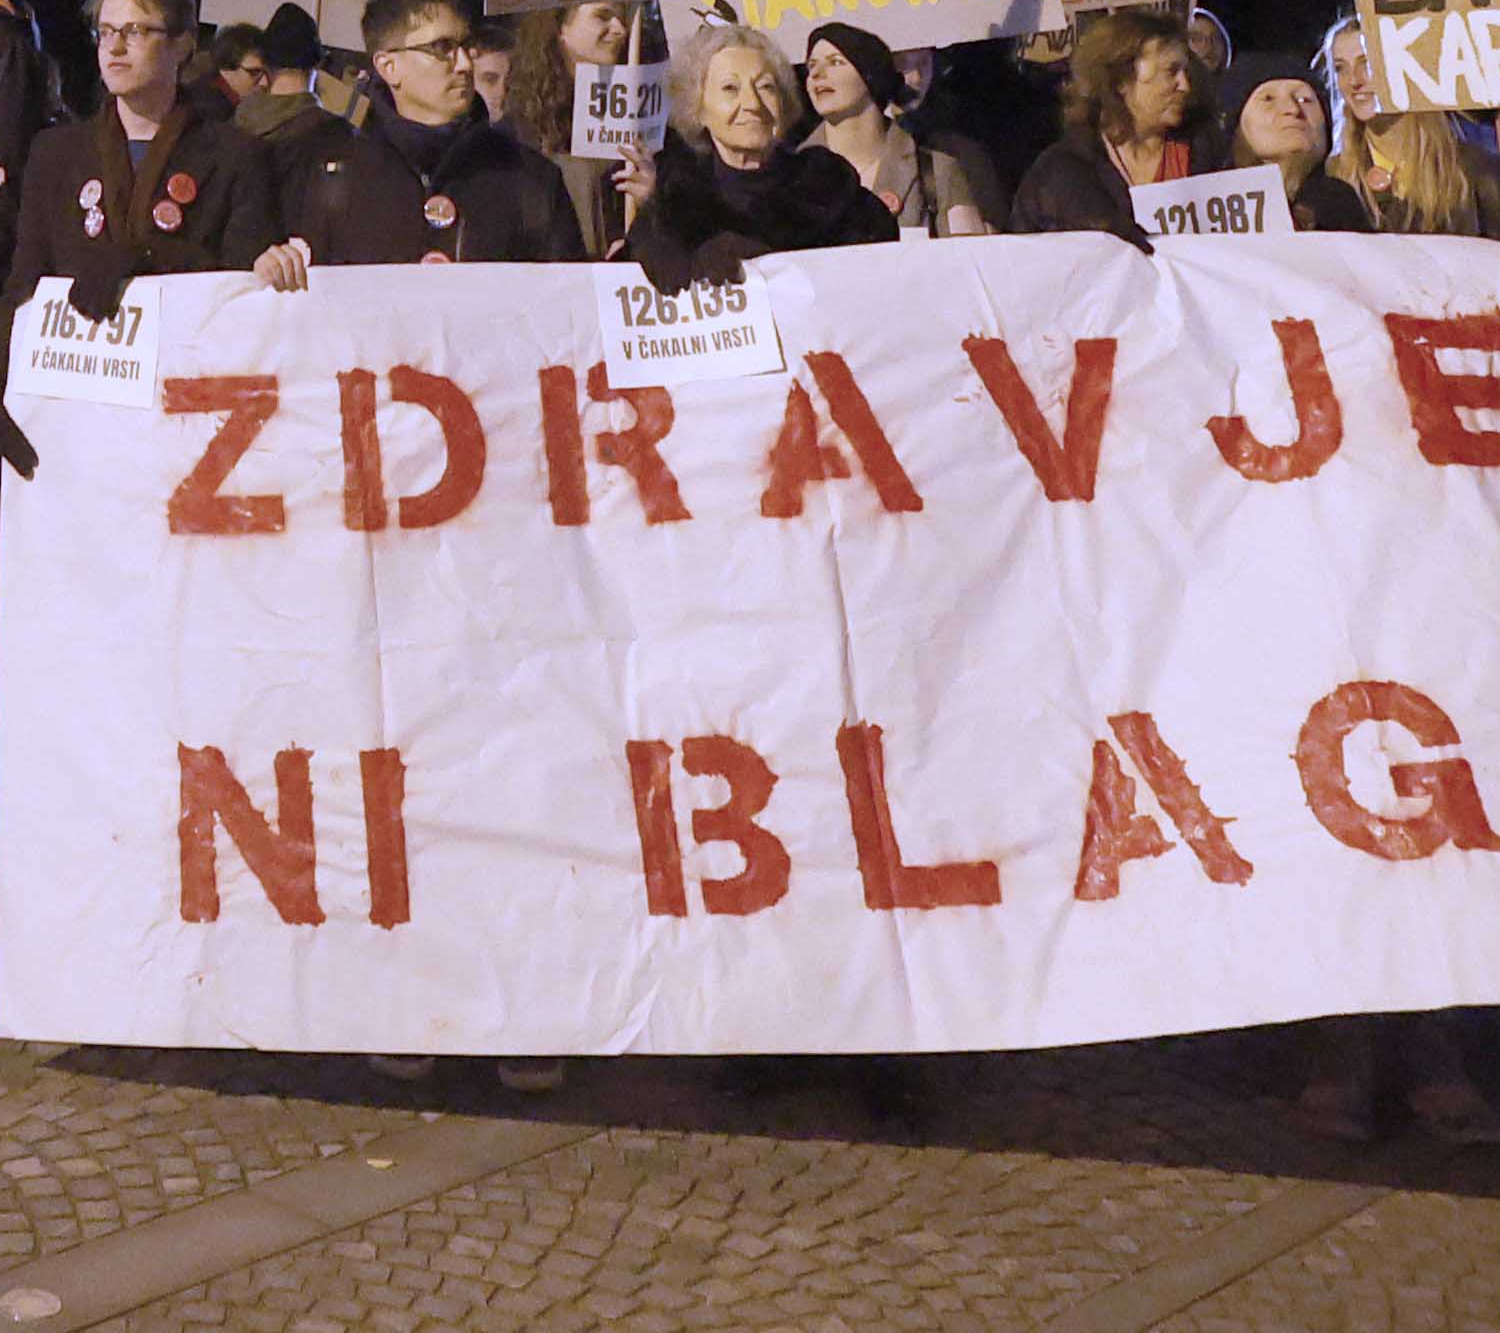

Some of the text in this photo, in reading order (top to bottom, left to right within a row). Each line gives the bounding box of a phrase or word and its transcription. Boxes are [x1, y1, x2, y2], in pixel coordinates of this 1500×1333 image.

[1154, 191, 1265, 234] 121987
[615, 281, 747, 326] 126.135
[31, 346, 141, 381] V ČAKALNI VRSTI
[622, 325, 757, 360] V ČAKALNI VRSTI
[175, 741, 413, 929] NI
